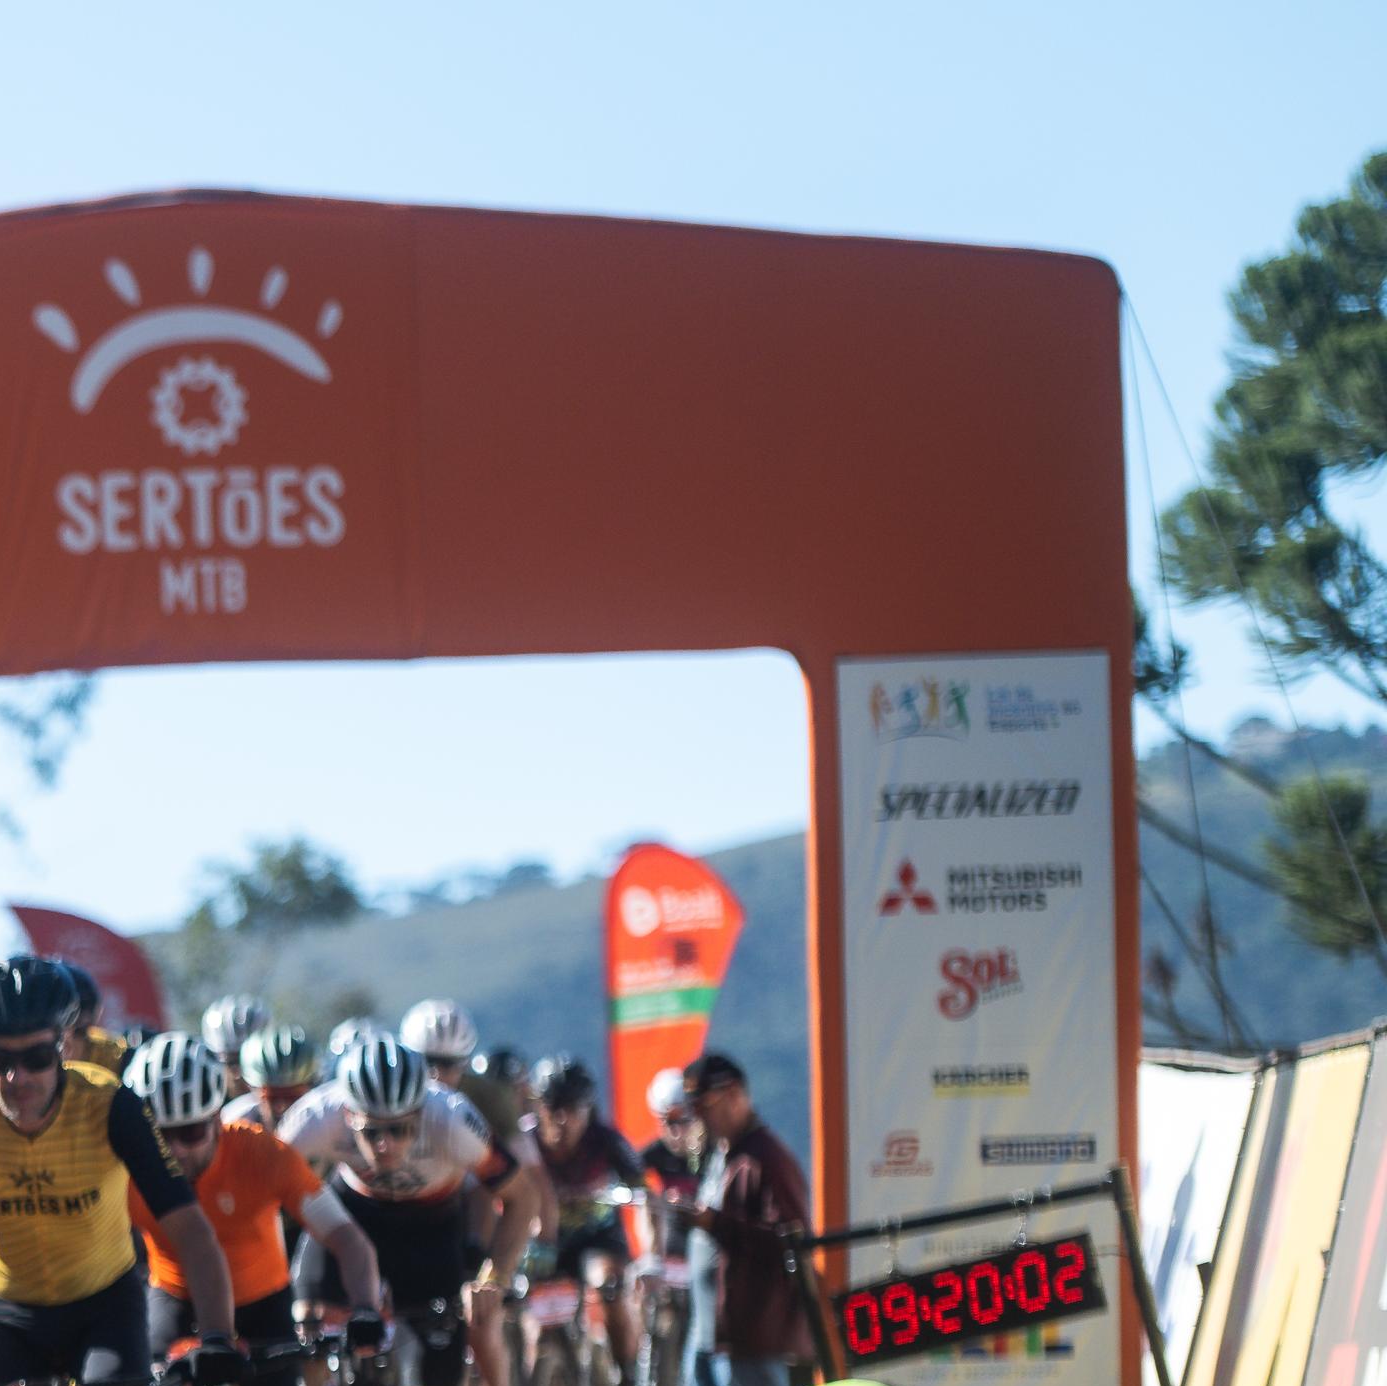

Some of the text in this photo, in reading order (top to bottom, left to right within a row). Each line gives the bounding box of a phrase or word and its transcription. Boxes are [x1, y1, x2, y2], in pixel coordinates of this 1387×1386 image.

[57, 466, 345, 554] SERTÕES
[160, 557, 247, 615] MTB
[877, 778, 1081, 822] SPECIALIZED
[946, 864, 1083, 890] MITSUBISHI
[947, 892, 1048, 914] MOTORS
[843, 1242, 1087, 1356] 09:20:02
